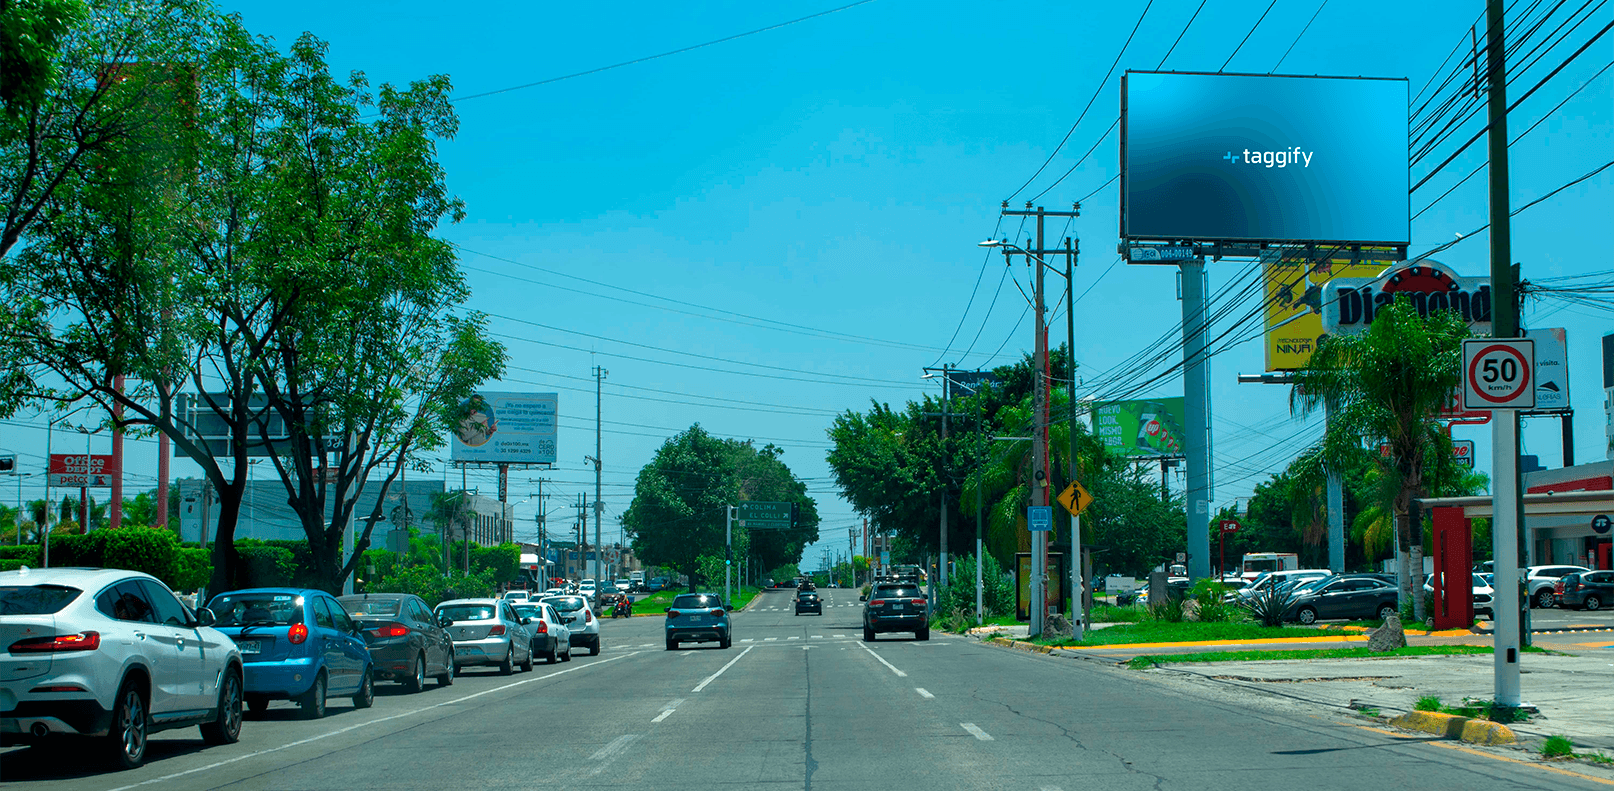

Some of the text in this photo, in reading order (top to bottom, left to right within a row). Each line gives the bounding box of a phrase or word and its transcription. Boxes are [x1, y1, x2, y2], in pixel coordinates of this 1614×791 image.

[1243, 147, 1313, 168] taggify
[1482, 358, 1517, 383] 50
[1099, 426, 1122, 436] MISMO
